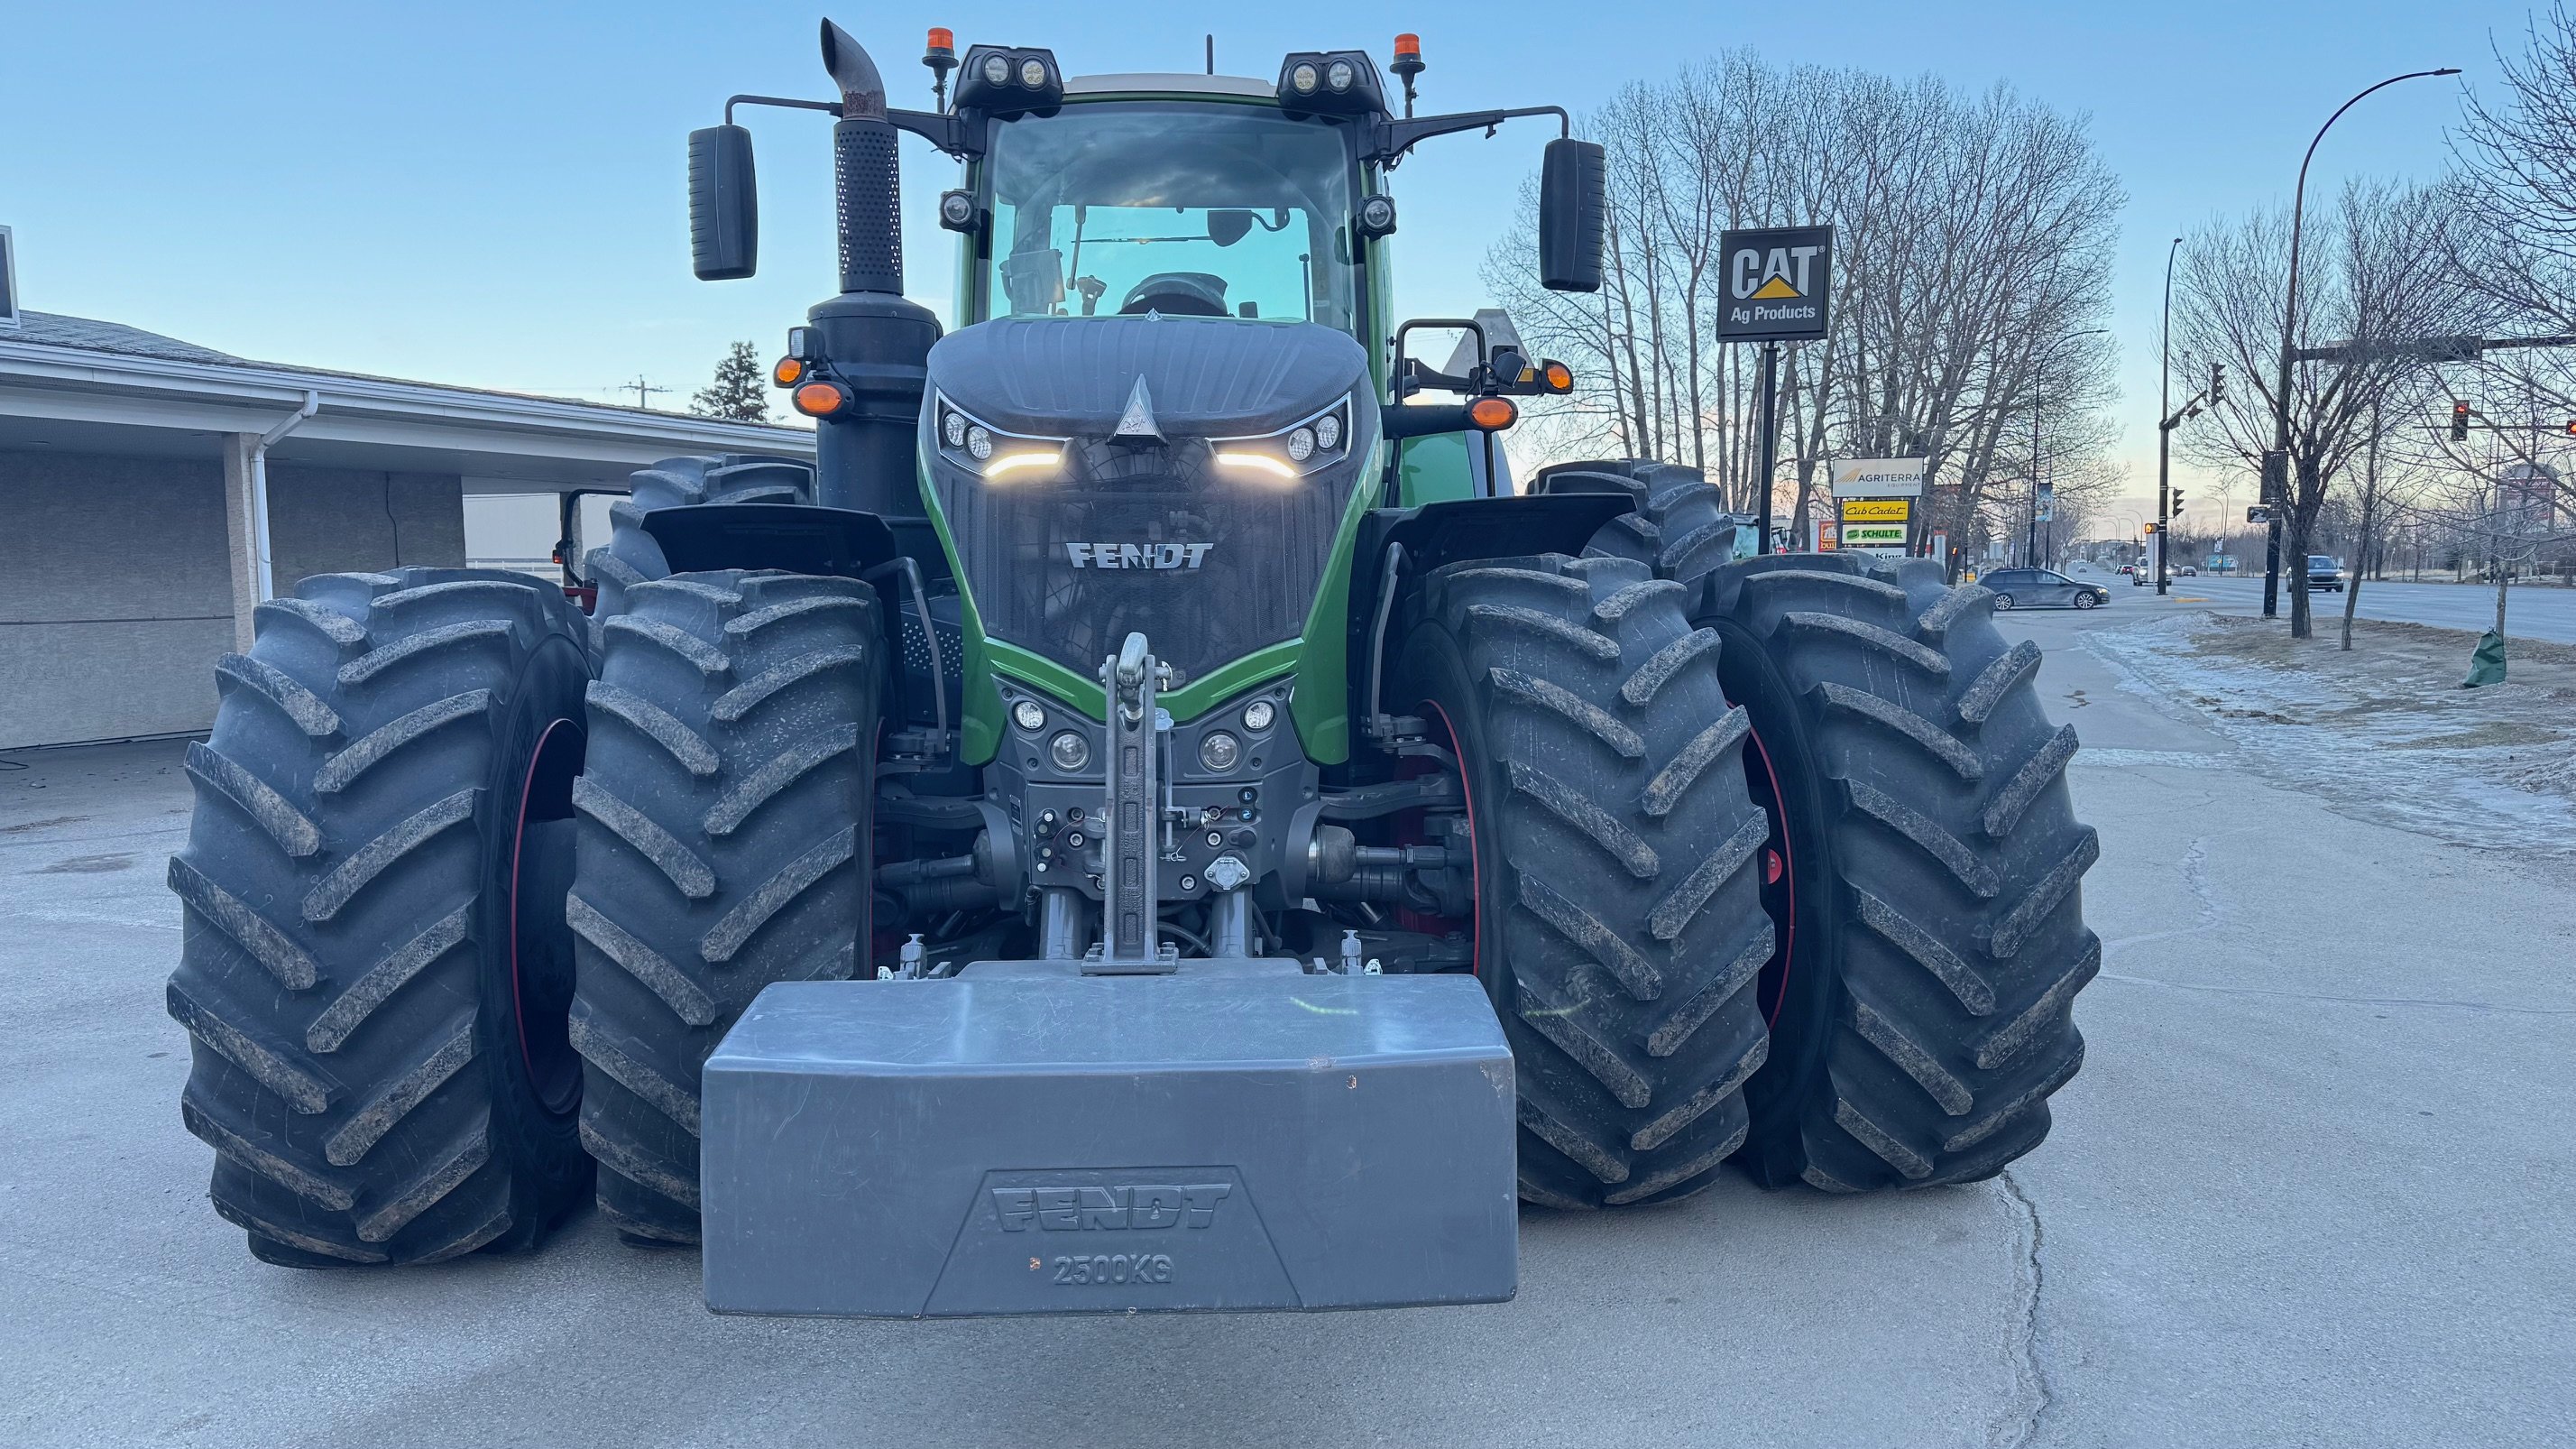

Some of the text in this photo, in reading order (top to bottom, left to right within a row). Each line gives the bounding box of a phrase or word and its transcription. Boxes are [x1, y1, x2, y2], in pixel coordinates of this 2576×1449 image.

[1732, 246, 1817, 300] CAT
[1731, 305, 1816, 324] Ag Products
[1858, 474, 1920, 482] AGRITERRA
[1861, 530, 1902, 539] SCHULTE
[1066, 543, 1214, 568] FENDT
[992, 1184, 1231, 1232] FENDT
[1053, 1254, 1172, 1285] 2500KG
